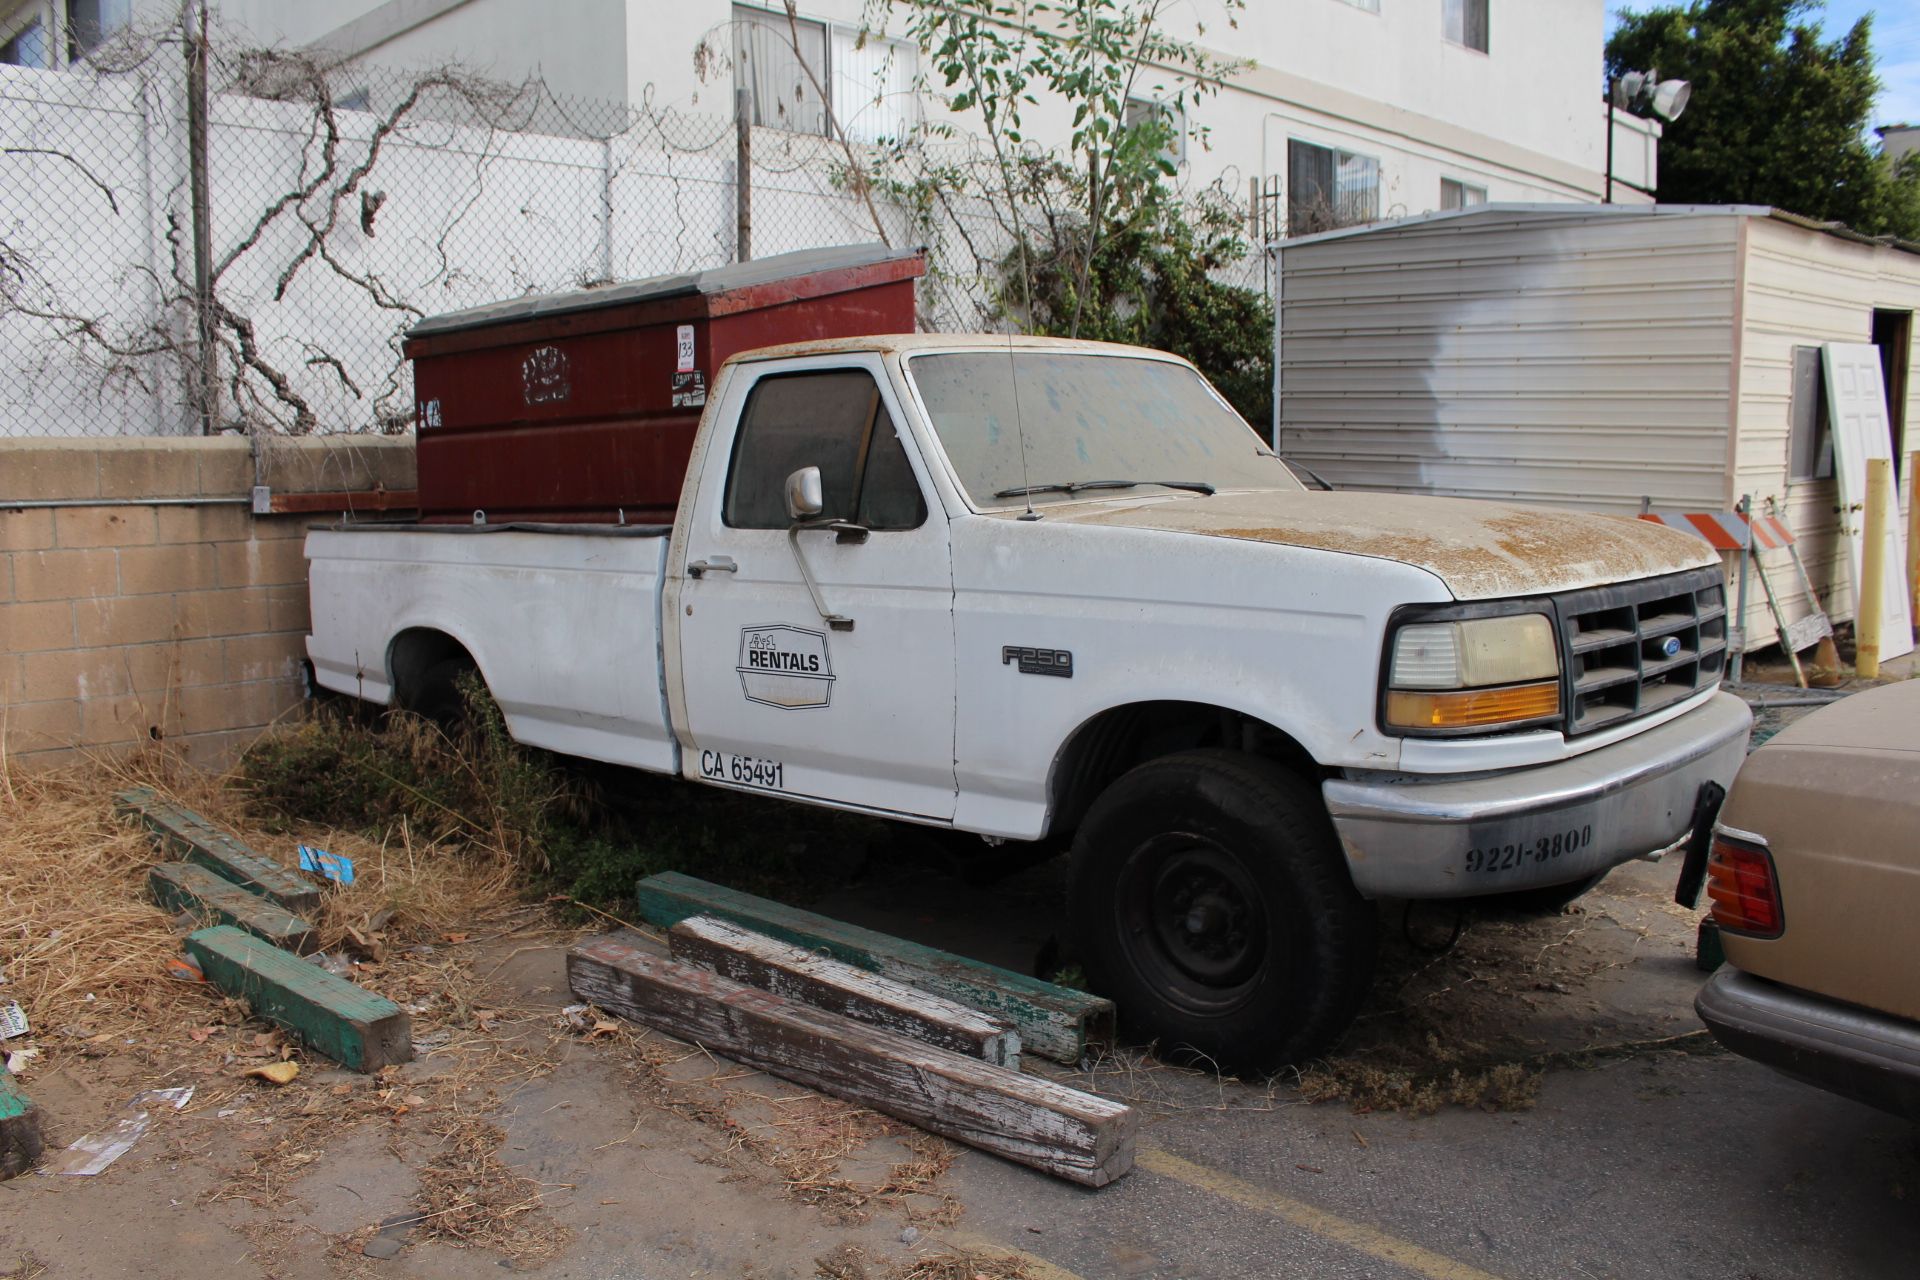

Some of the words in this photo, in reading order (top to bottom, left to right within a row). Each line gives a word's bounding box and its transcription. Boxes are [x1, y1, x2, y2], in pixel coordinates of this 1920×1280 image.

[679, 341, 693, 359] 133
[749, 633, 776, 651] A-1
[749, 650, 820, 672] RENTALS
[1002, 645, 1071, 667] F250
[701, 749, 725, 778] CA
[732, 755, 784, 788] 65491
